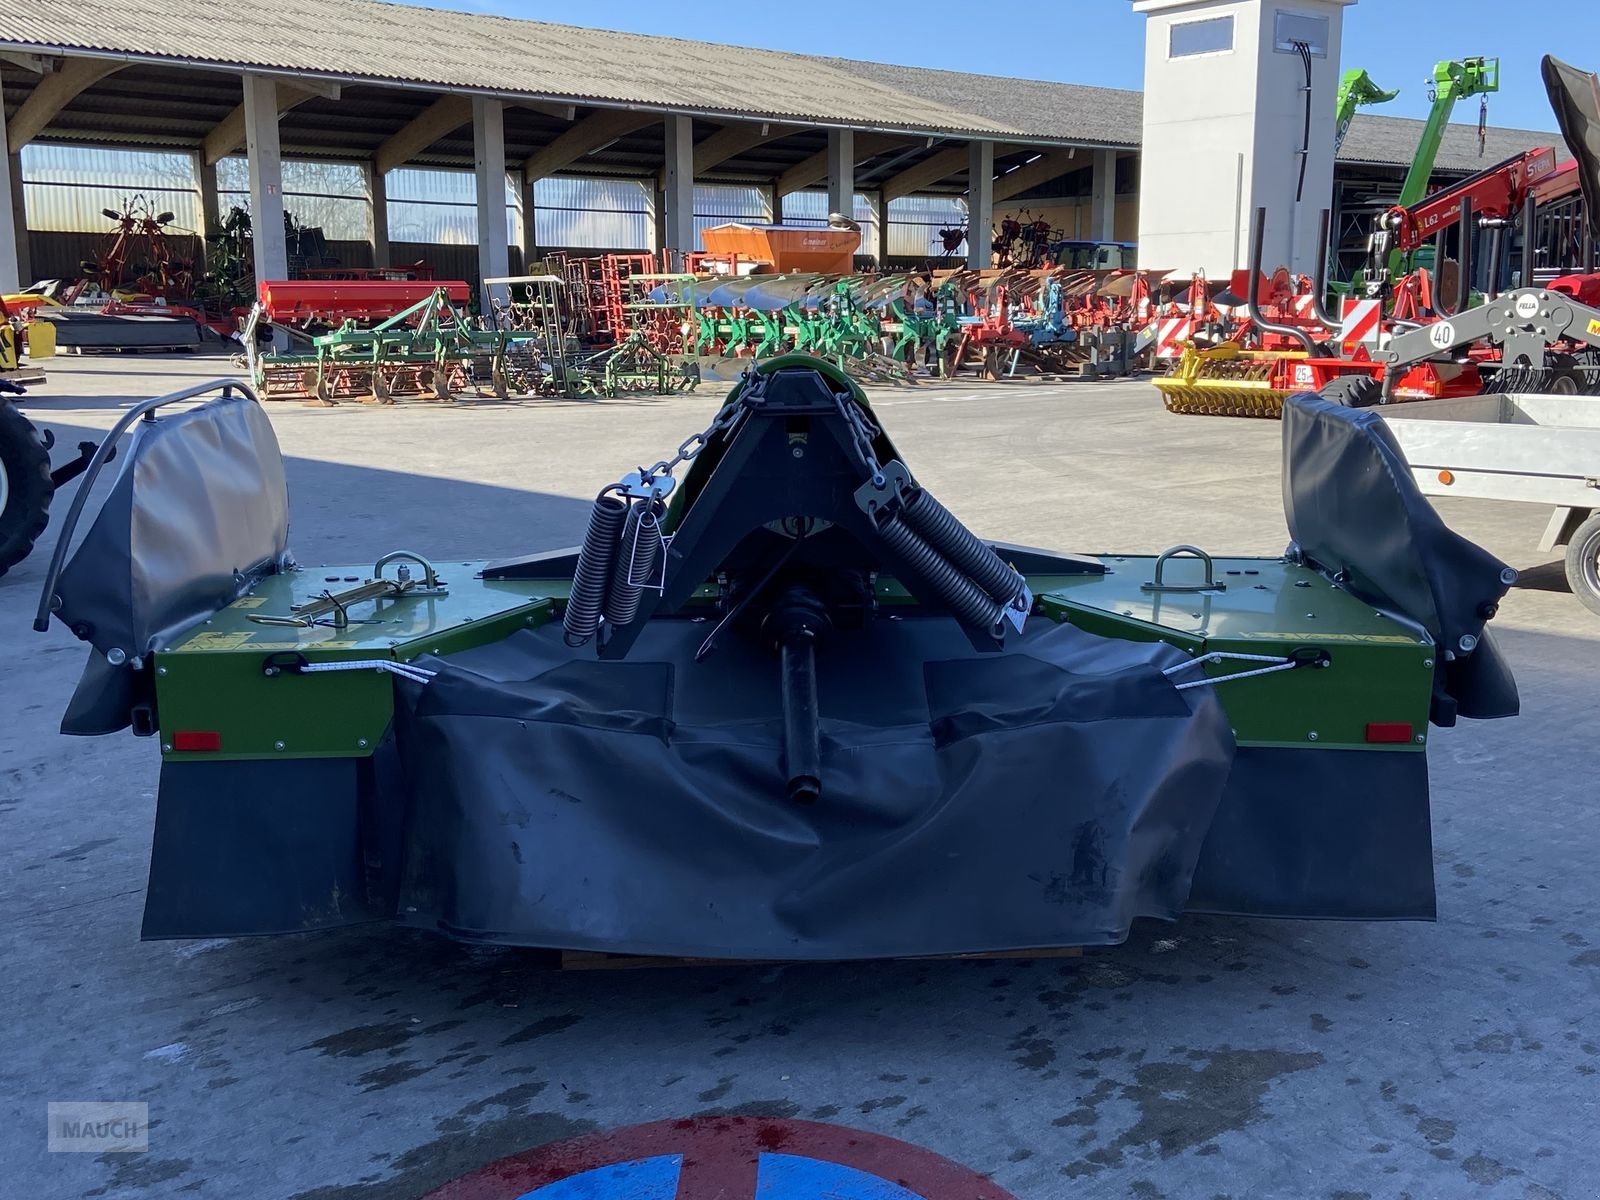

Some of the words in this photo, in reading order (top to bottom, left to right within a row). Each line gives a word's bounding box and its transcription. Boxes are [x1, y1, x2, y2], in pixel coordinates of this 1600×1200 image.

[1424, 213, 1439, 228] L62
[1518, 302, 1536, 310] FELLA
[1434, 325, 1450, 344] 40
[1296, 367, 1307, 381] 25
